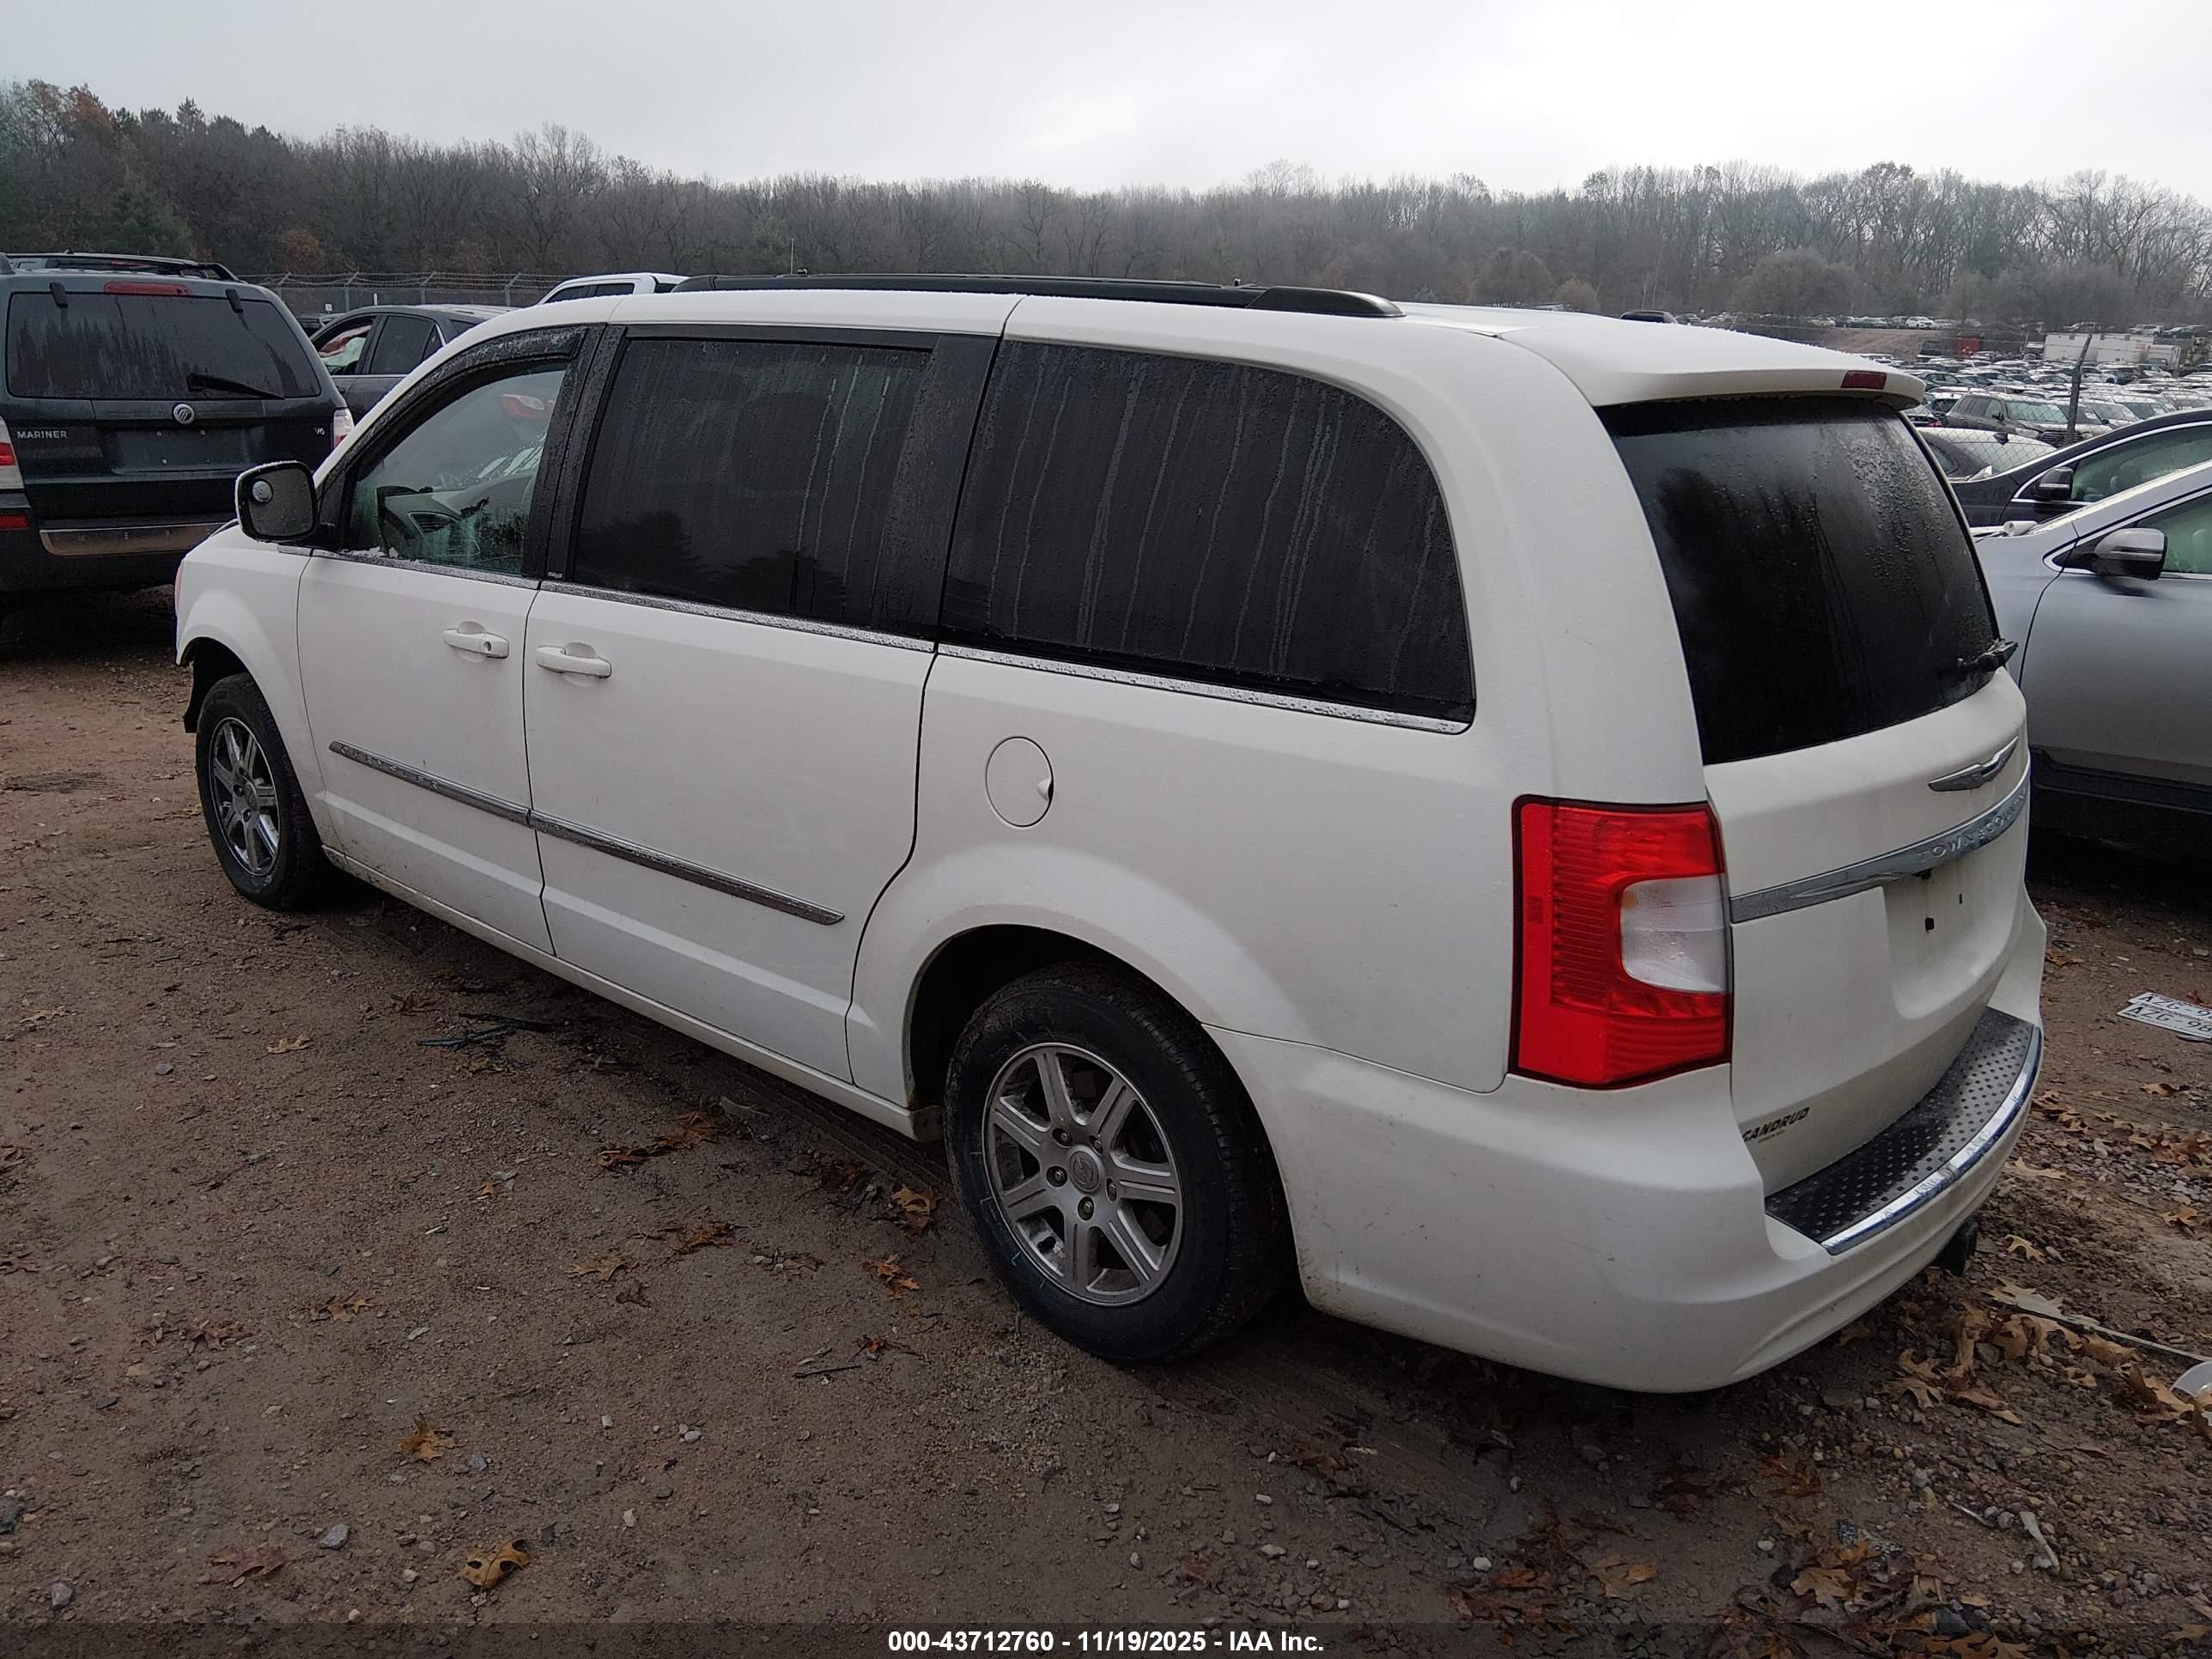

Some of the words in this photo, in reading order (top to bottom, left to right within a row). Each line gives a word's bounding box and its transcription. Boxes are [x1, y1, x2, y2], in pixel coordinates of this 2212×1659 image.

[16, 430, 68, 440] MARINER
[313, 426, 325, 435] V6
[1916, 832, 1975, 863] TOWN
